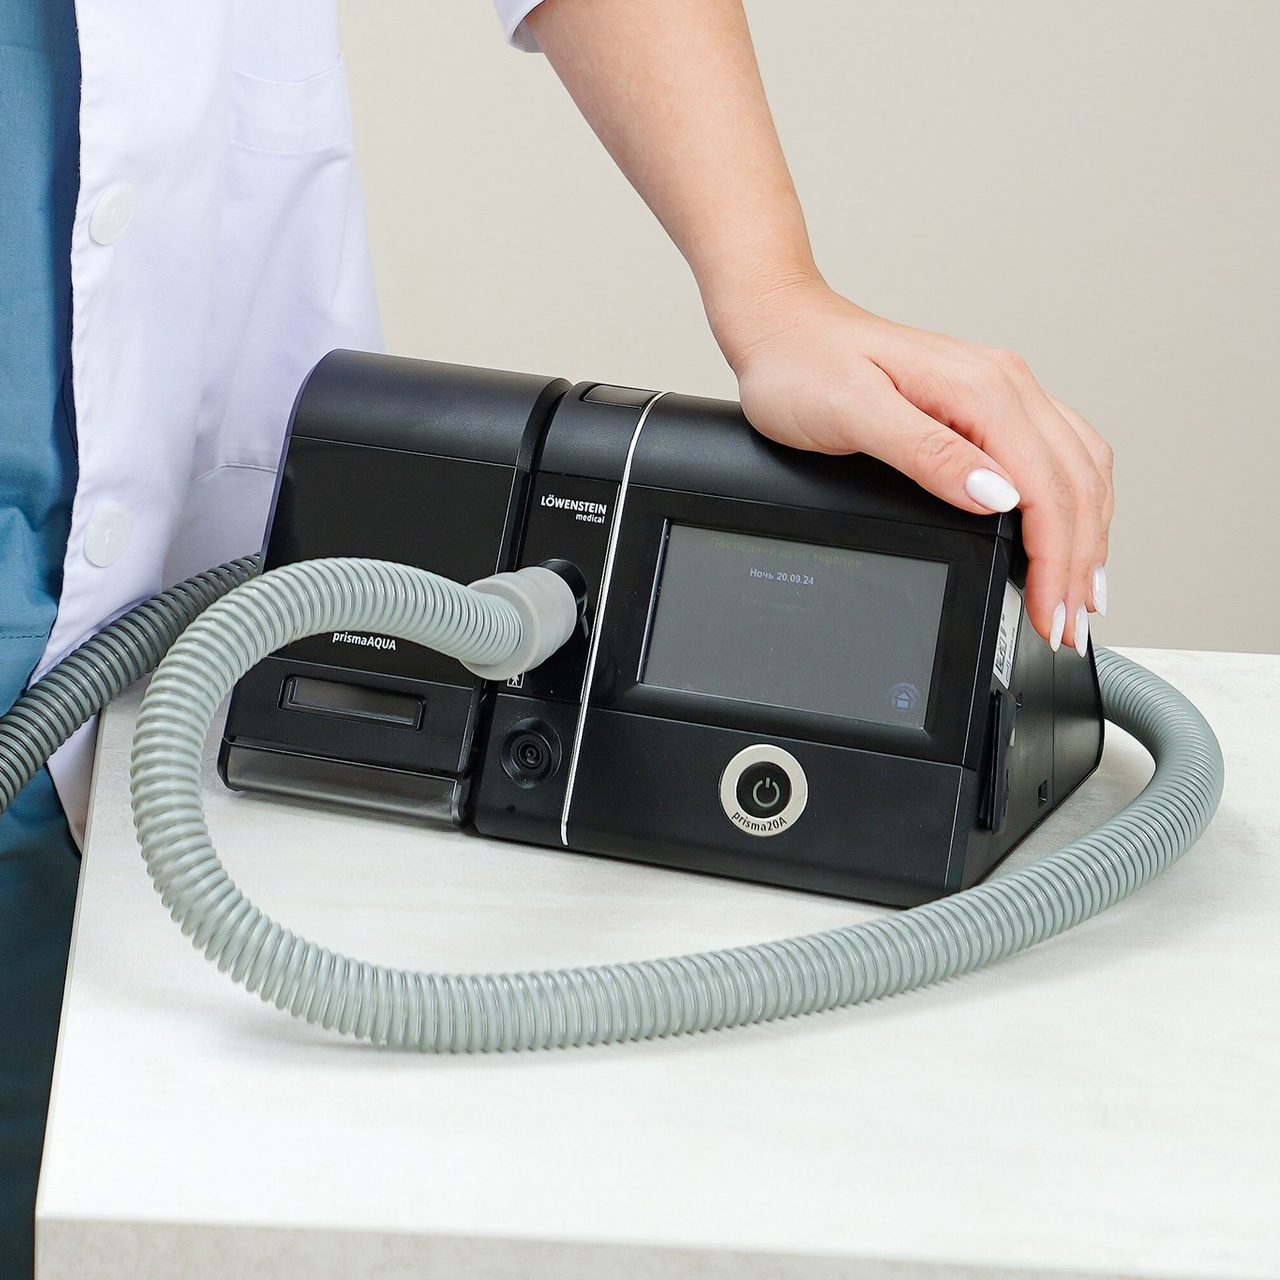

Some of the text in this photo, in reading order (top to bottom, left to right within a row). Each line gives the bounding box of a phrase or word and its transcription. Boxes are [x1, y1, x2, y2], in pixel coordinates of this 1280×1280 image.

[540, 494, 607, 515] LÖWENSTEIN
[575, 513, 605, 524] medical
[749, 568, 815, 586] Ночь 20.09.24
[332, 632, 396, 651] prismaAQUA
[732, 811, 787, 831] prisma20A
